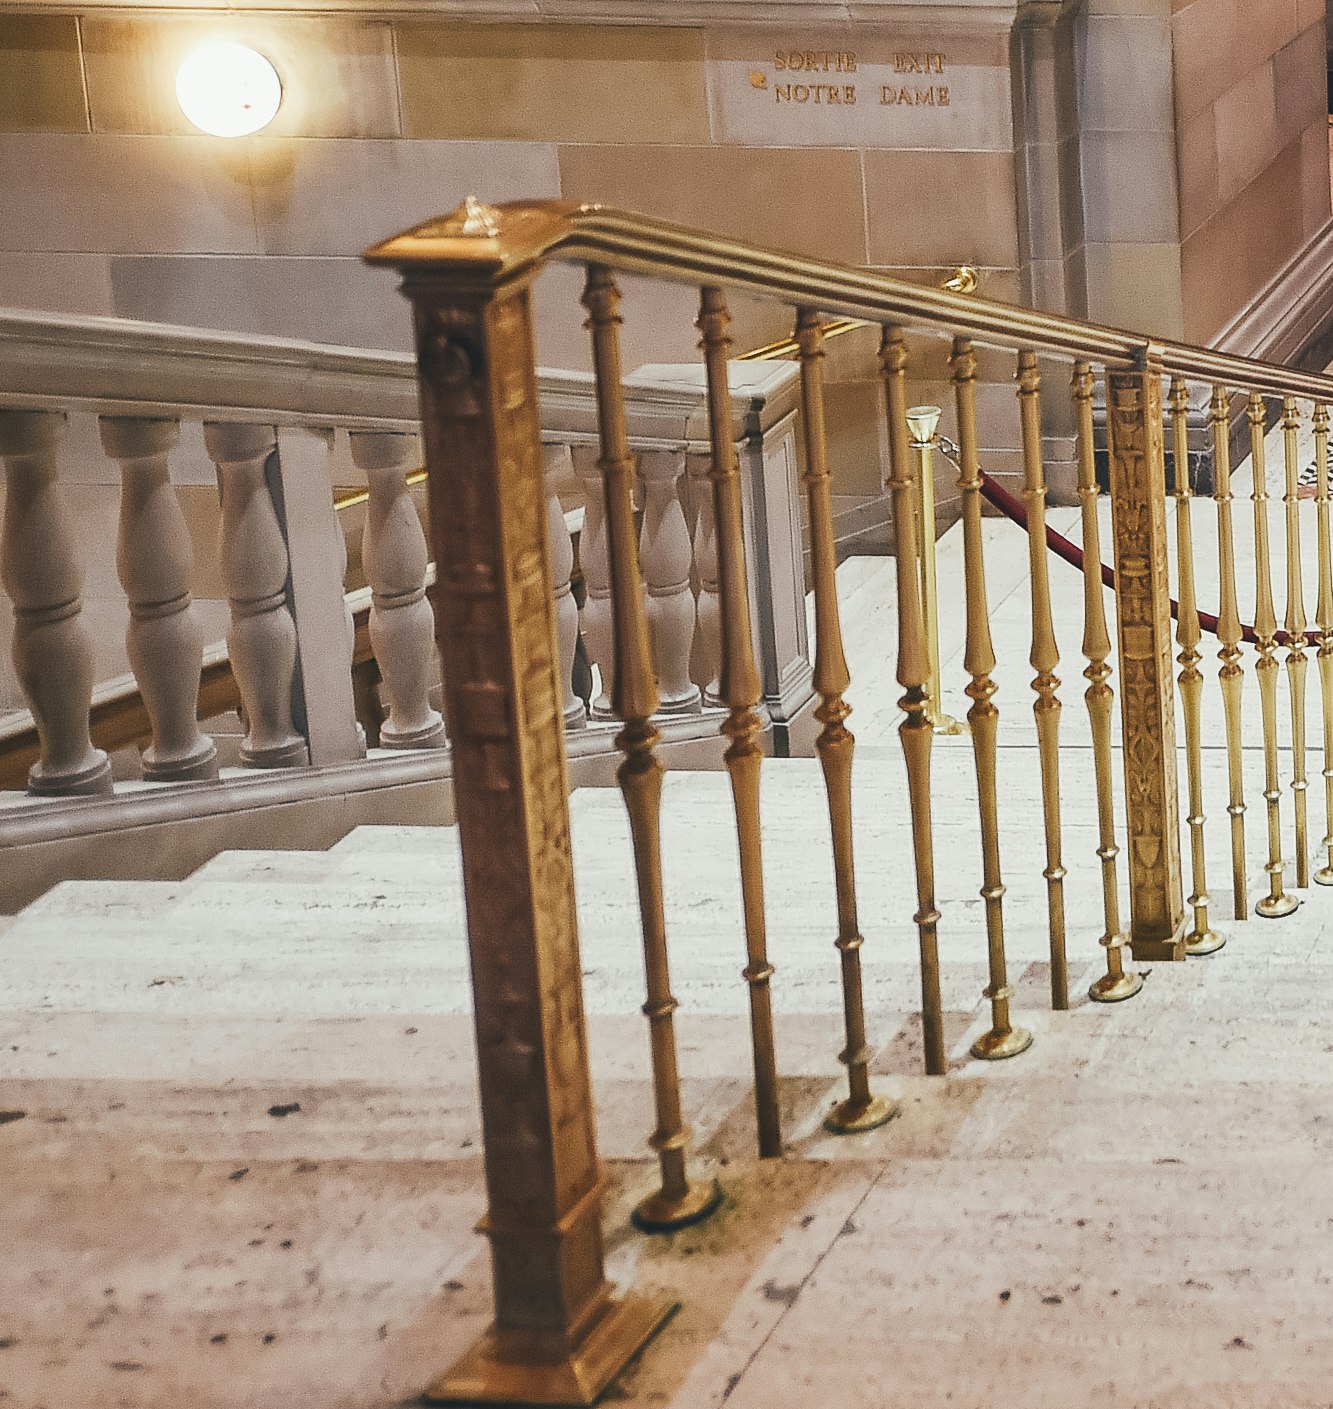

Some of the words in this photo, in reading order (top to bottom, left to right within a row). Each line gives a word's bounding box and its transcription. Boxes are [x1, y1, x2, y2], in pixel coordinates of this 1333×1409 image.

[774, 50, 857, 73] SORTIE
[892, 52, 947, 74] EXIT
[774, 83, 857, 105] NOTRE
[879, 84, 950, 106] DAME
